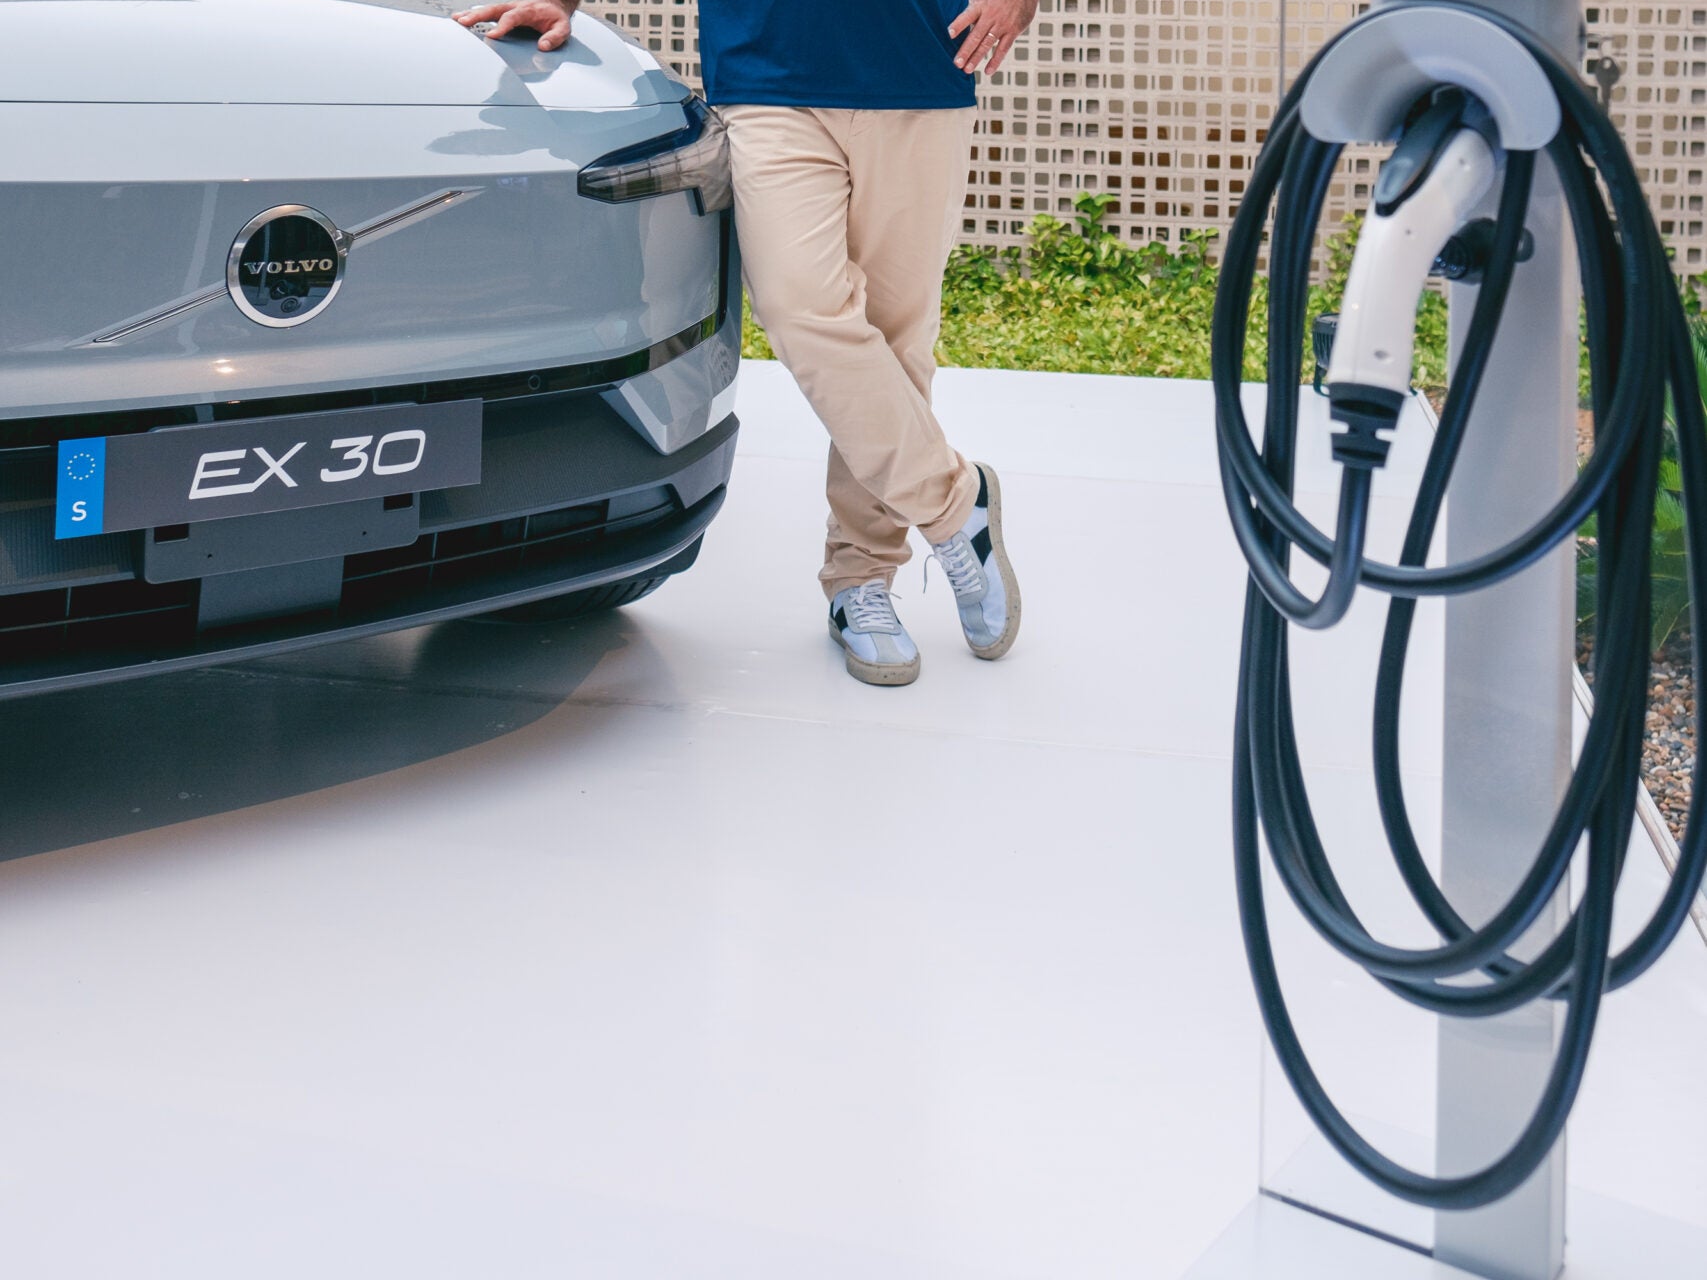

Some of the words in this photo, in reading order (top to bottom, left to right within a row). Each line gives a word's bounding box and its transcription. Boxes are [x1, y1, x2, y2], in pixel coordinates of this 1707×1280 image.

[243, 258, 333, 275] VOLVO
[188, 442, 307, 500] EX
[320, 429, 426, 483] 30
[71, 500, 87, 522] S
